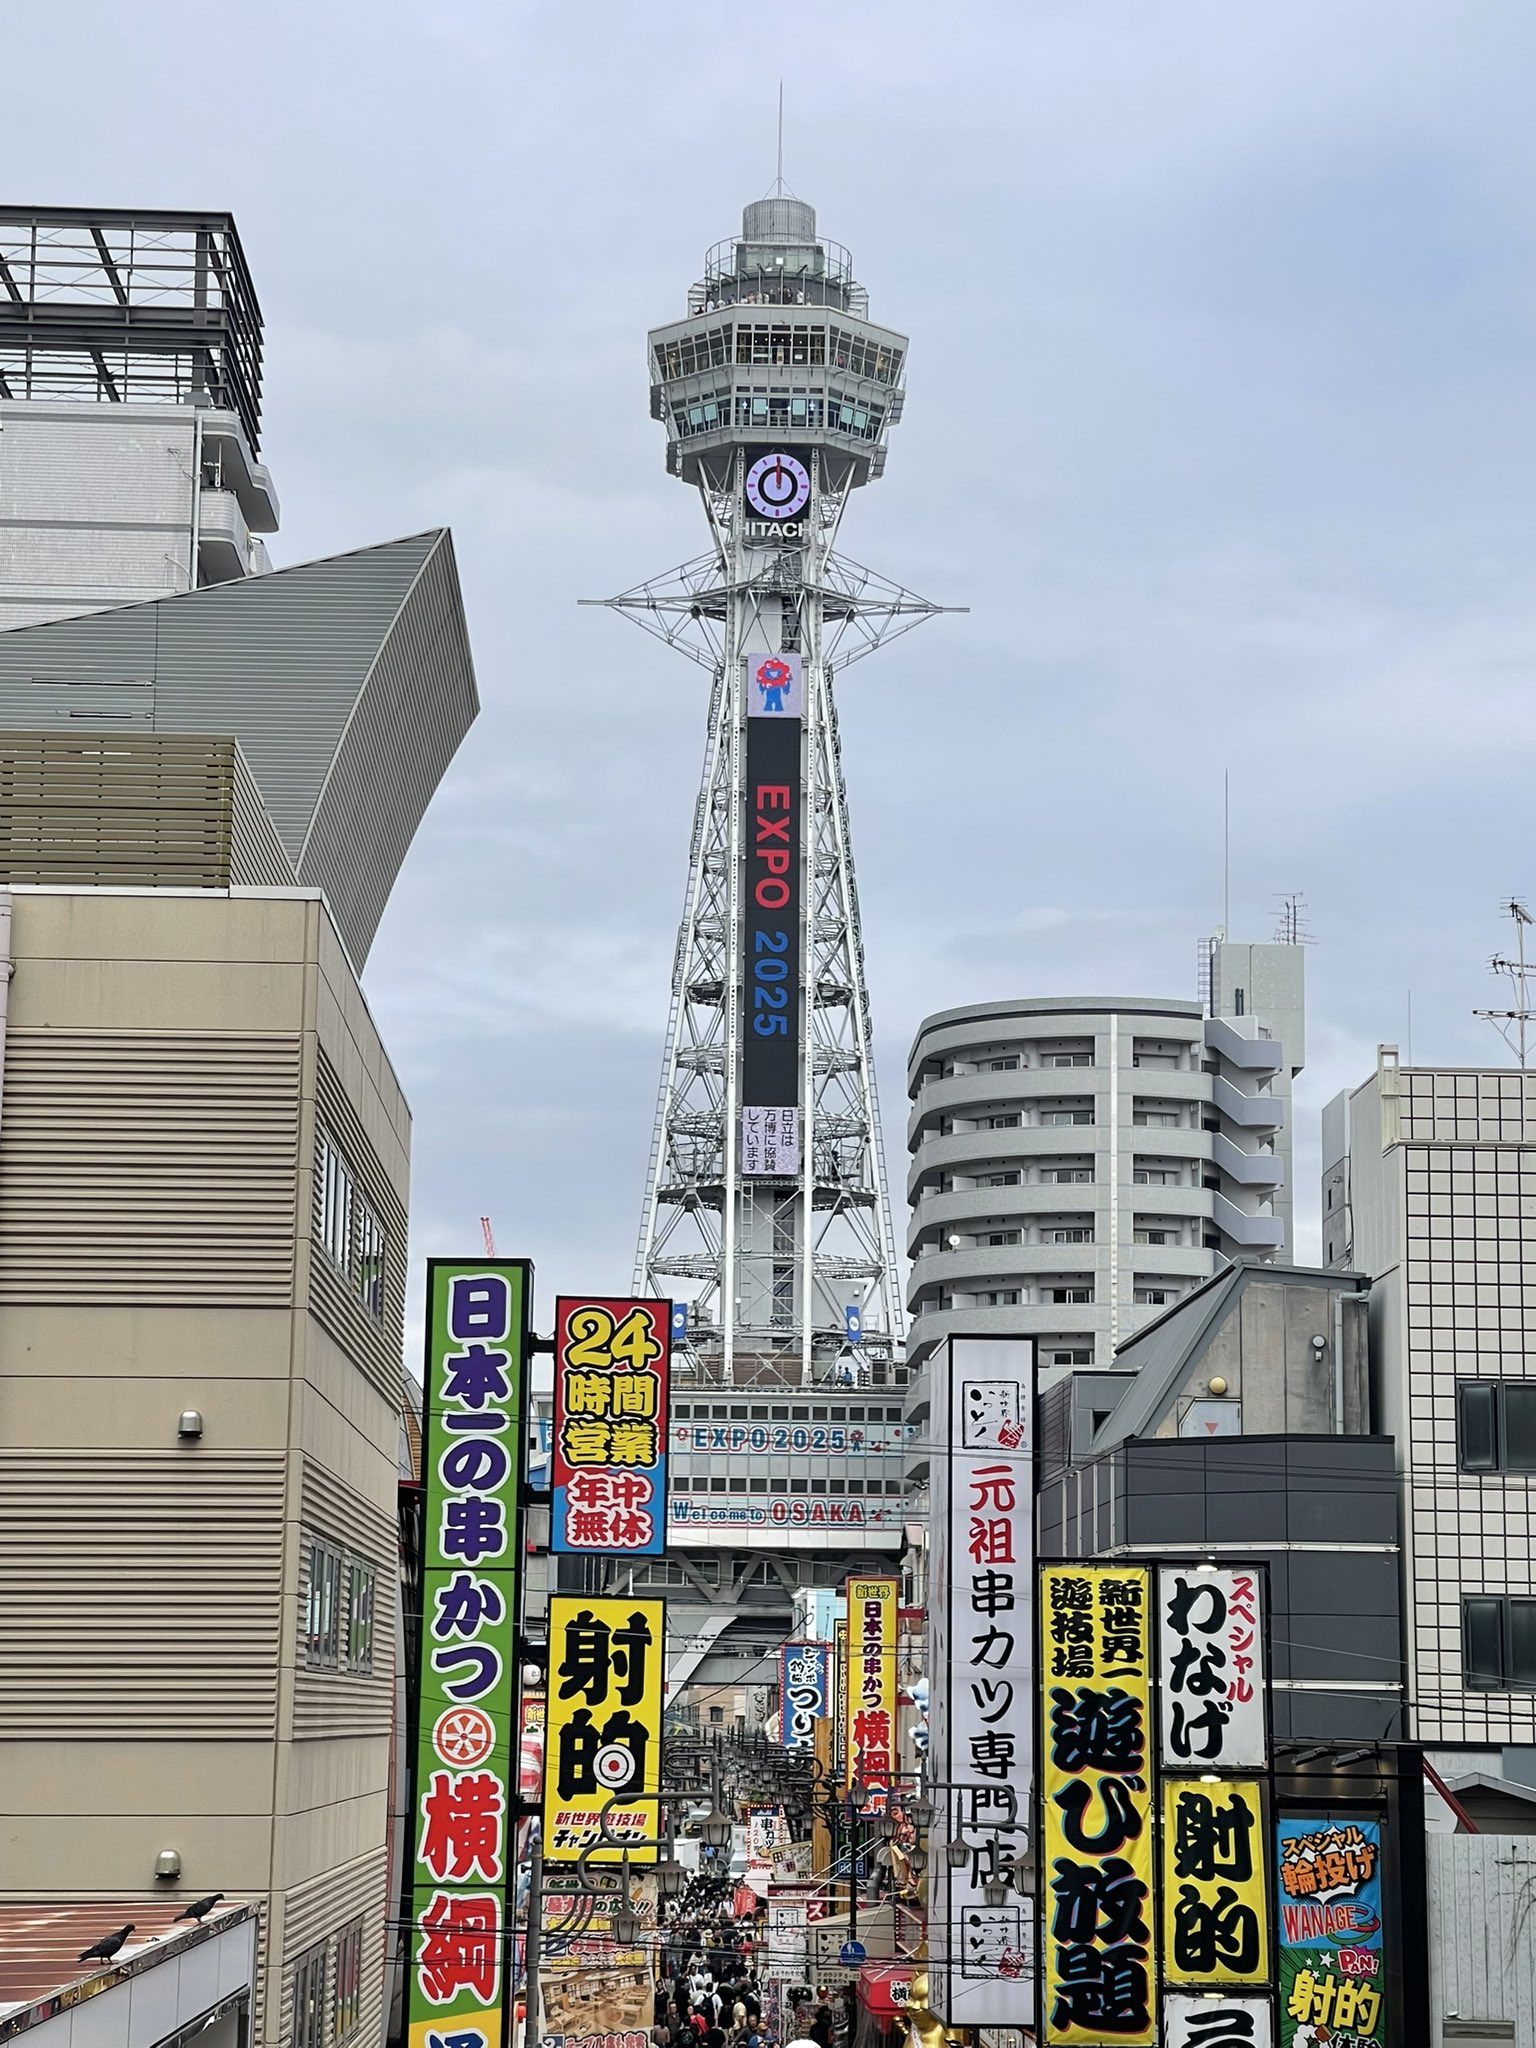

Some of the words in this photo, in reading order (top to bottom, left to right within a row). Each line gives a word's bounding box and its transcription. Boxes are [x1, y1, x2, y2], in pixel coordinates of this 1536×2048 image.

[755, 785, 790, 908] EXPO
[754, 931, 789, 1036] 2025
[747, 1109, 759, 1171] しています
[781, 1110, 794, 1146] 日立は
[566, 1309, 659, 1369] 24
[566, 1374, 656, 1418] 時間
[564, 1420, 655, 1465] 営業
[435, 1277, 508, 1699] 日本一の串かつ
[571, 1475, 650, 1509] 年中
[674, 1501, 747, 1521] Welcome
[749, 1507, 763, 1521] to
[771, 1500, 864, 1524] OSAKA
[571, 1509, 650, 1544] 無休
[856, 1585, 890, 1599] 新世界
[862, 1601, 882, 1708] 日本一の串かつ
[1050, 1577, 1094, 1678] 遊技場
[1227, 1576, 1256, 1703] スペシャル
[969, 1465, 1016, 1889] 元祖串カツ専門店
[1166, 1577, 1233, 1759] わなげ
[556, 1610, 652, 1805] 射的
[853, 1711, 890, 1789] 横綱
[1050, 1686, 1152, 2034] 遊び放題
[1281, 1845, 1376, 1896] 輪投げ
[1282, 1827, 1363, 1857] スペシャル
[421, 1773, 503, 2002] 横綱
[1174, 1791, 1261, 1974] 射的
[1282, 1904, 1359, 1944] WANAGE
[1339, 1950, 1378, 1974] PAN!
[1288, 1969, 1380, 2035] 射的
